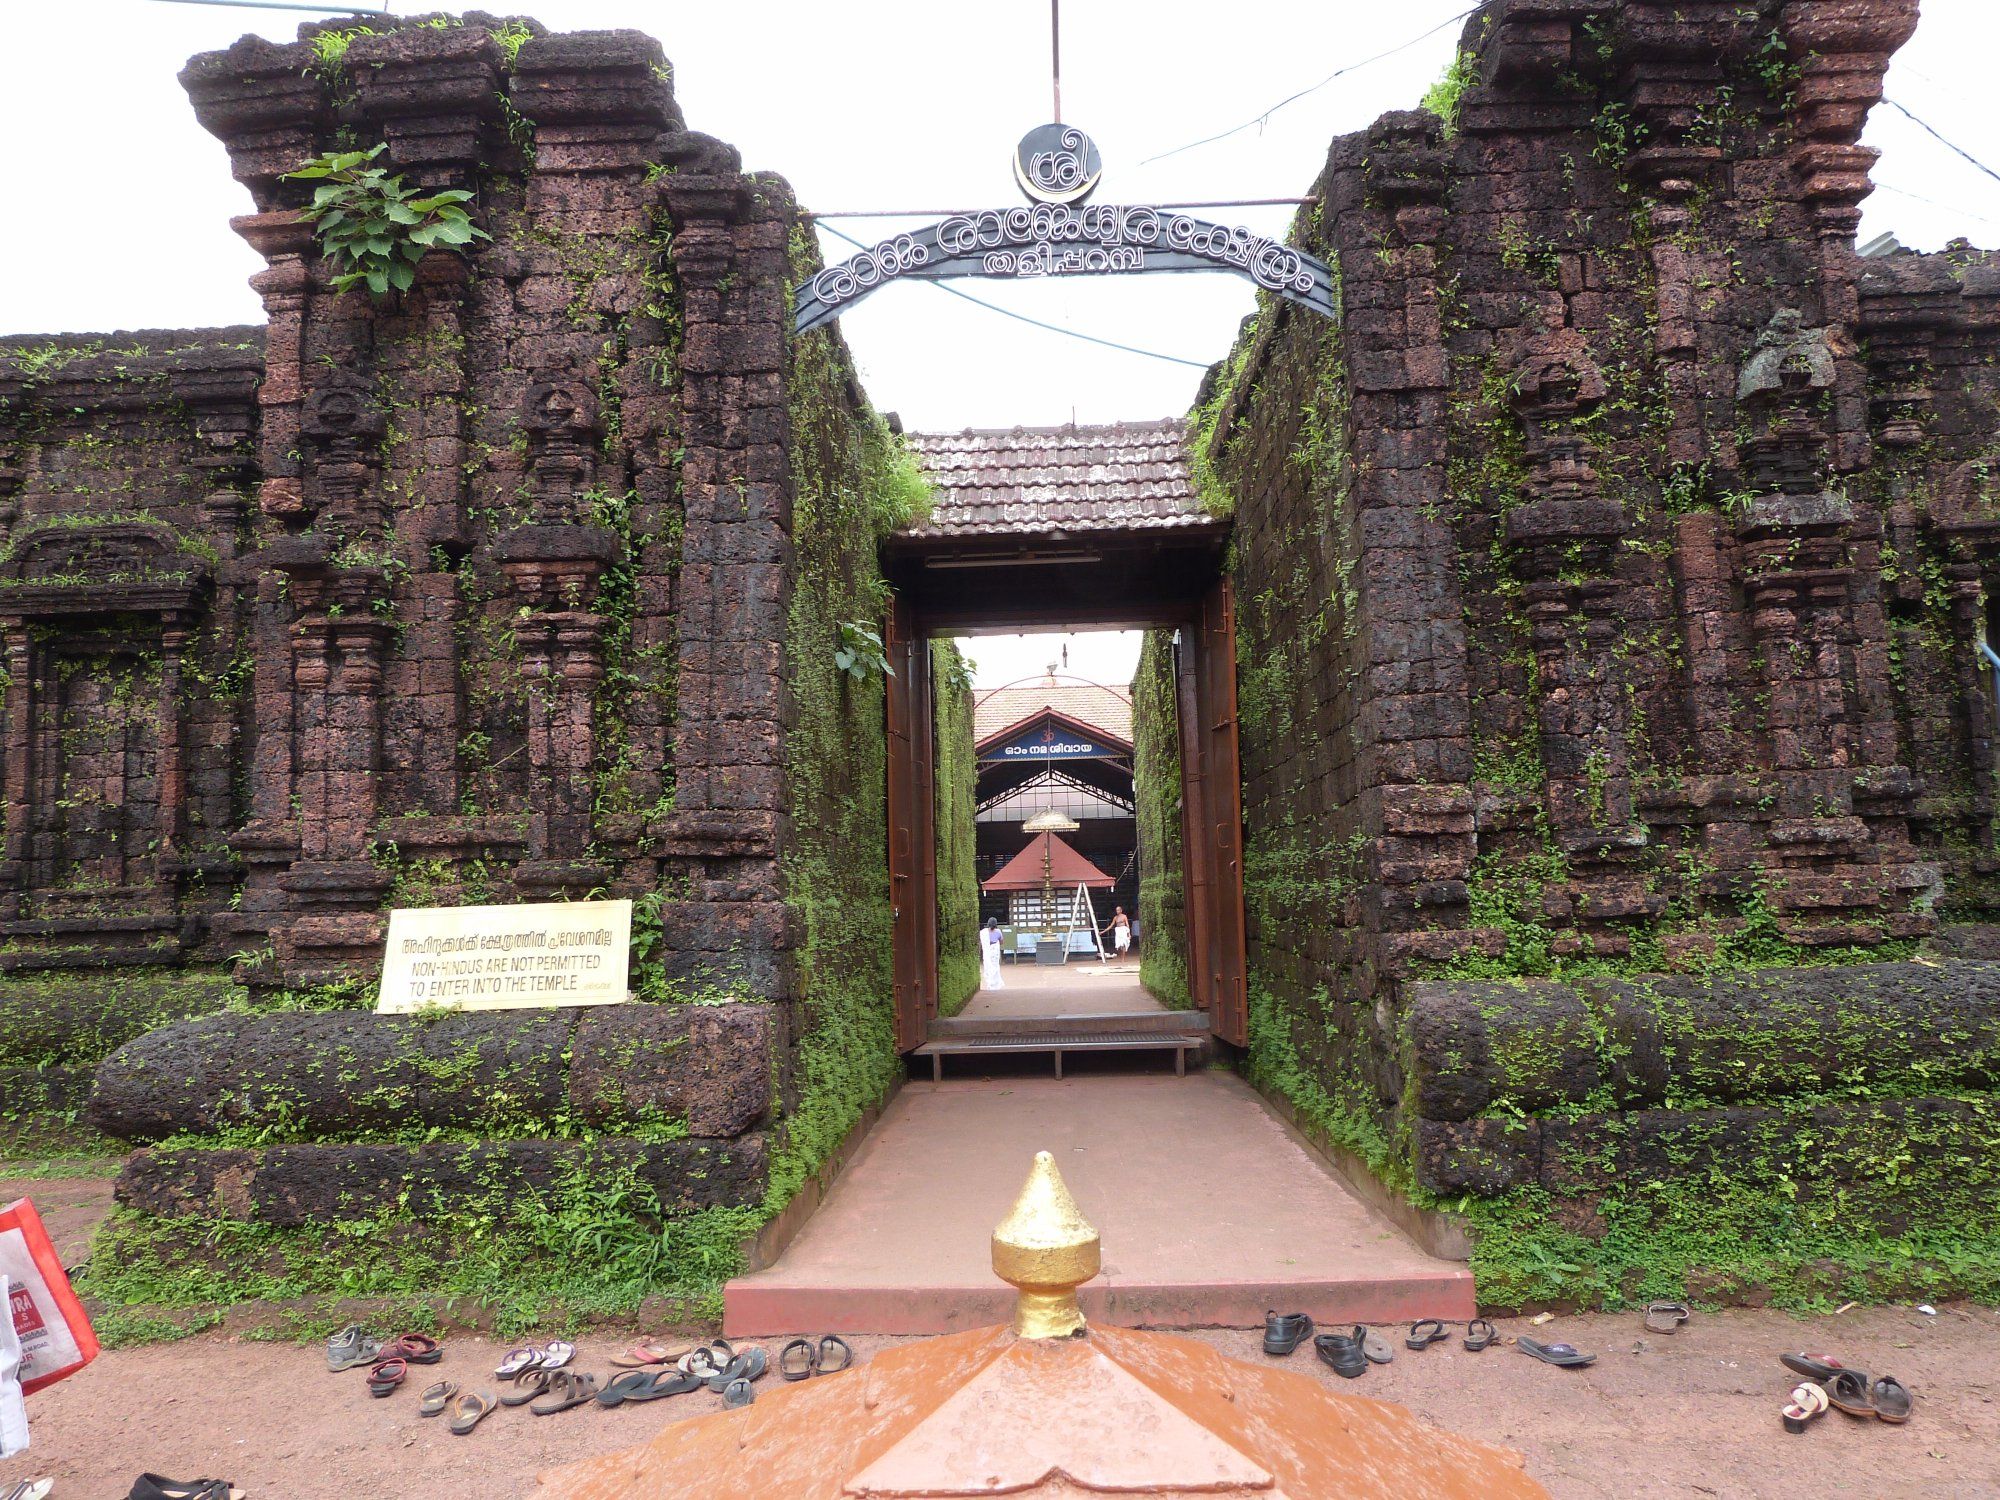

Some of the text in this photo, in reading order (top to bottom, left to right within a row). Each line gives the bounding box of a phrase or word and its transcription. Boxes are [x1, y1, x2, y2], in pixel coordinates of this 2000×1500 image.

[1029, 127, 1089, 194] ശ്രീ
[1166, 214, 1315, 292] ക്ഷേത്രം
[410, 981, 425, 998] TO
[429, 979, 469, 997] ENTER
[473, 977, 502, 994] INTO
[505, 976, 527, 993] THE
[530, 974, 578, 992] TEMPLE
[411, 954, 601, 978] NON-HINDUS ARE NOT PERMITTED
